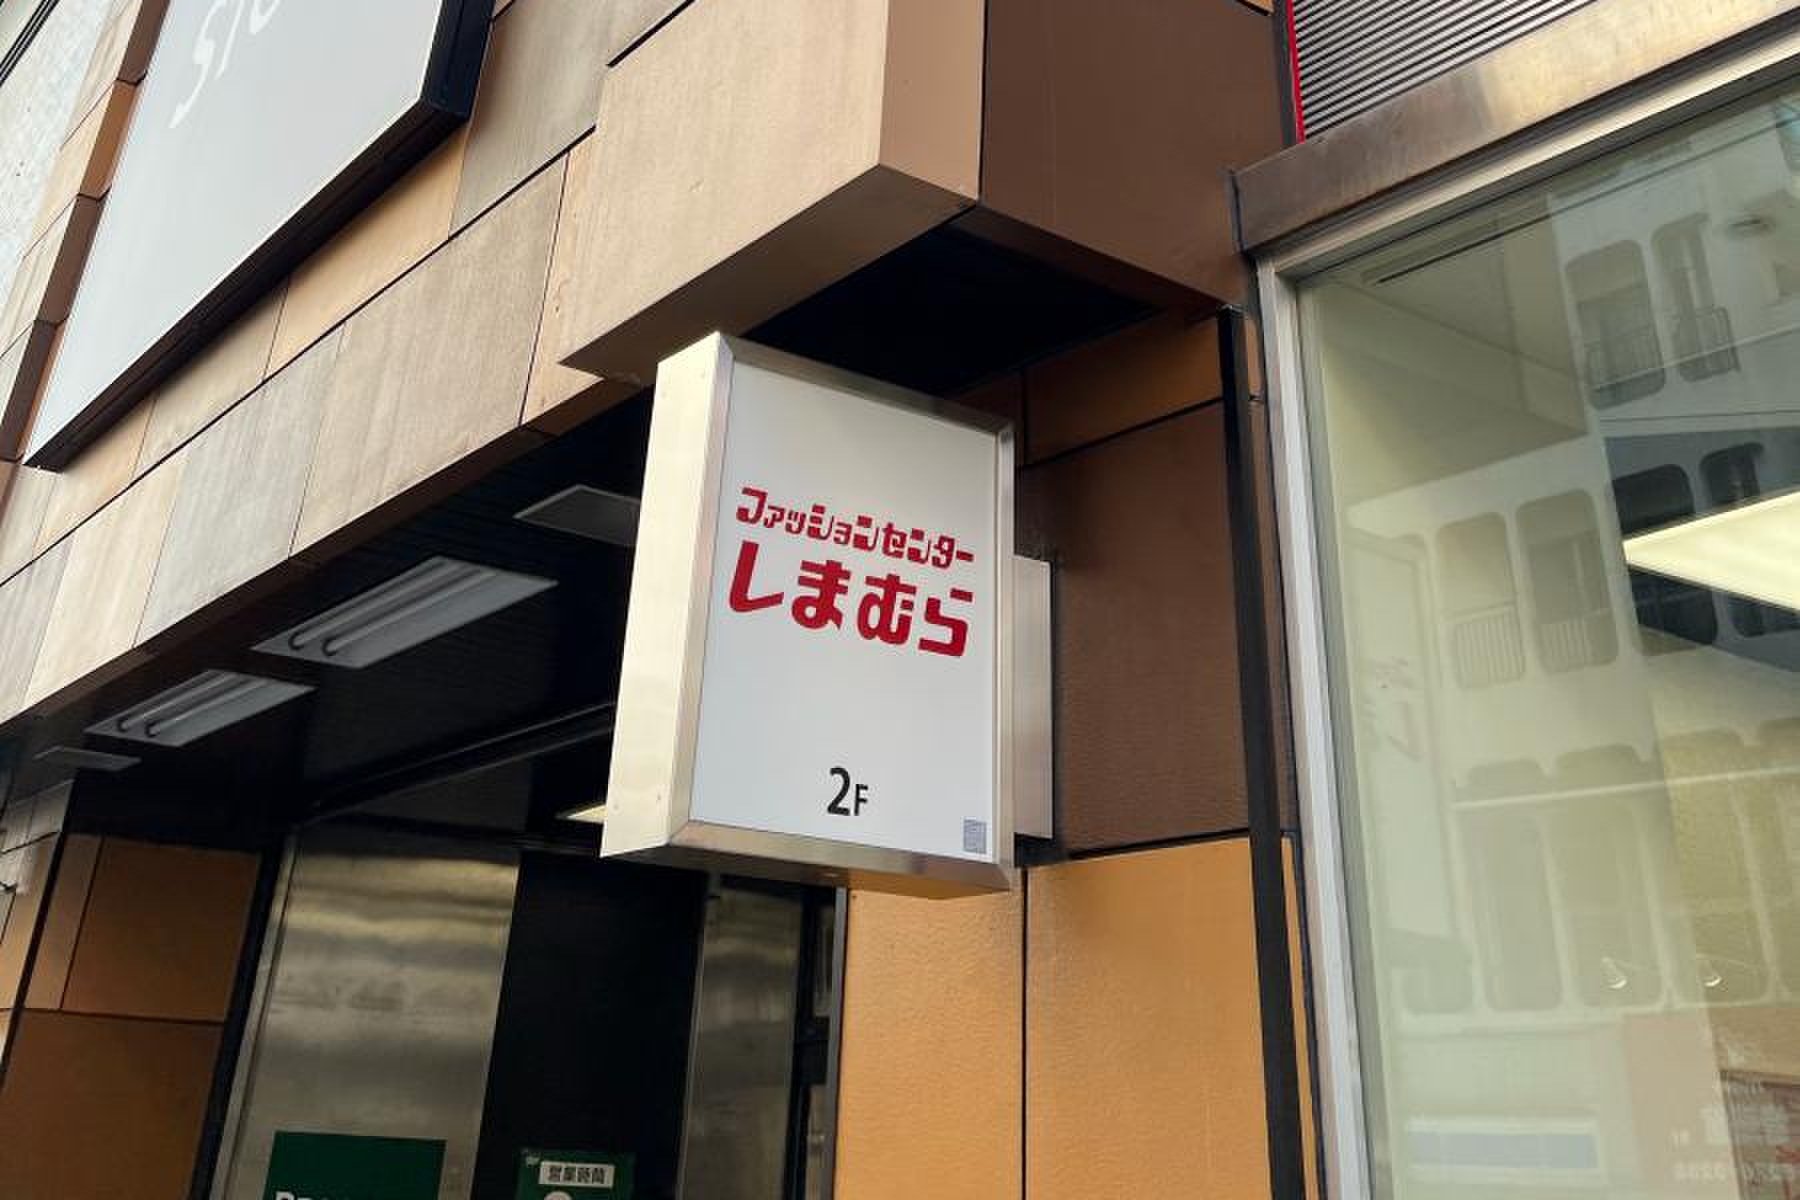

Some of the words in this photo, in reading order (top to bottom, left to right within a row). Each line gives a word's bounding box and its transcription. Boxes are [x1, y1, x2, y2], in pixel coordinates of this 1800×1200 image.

[736, 487, 974, 569] ファッションセンター
[729, 540, 973, 657] しまむら
[826, 765, 868, 816] 2F
